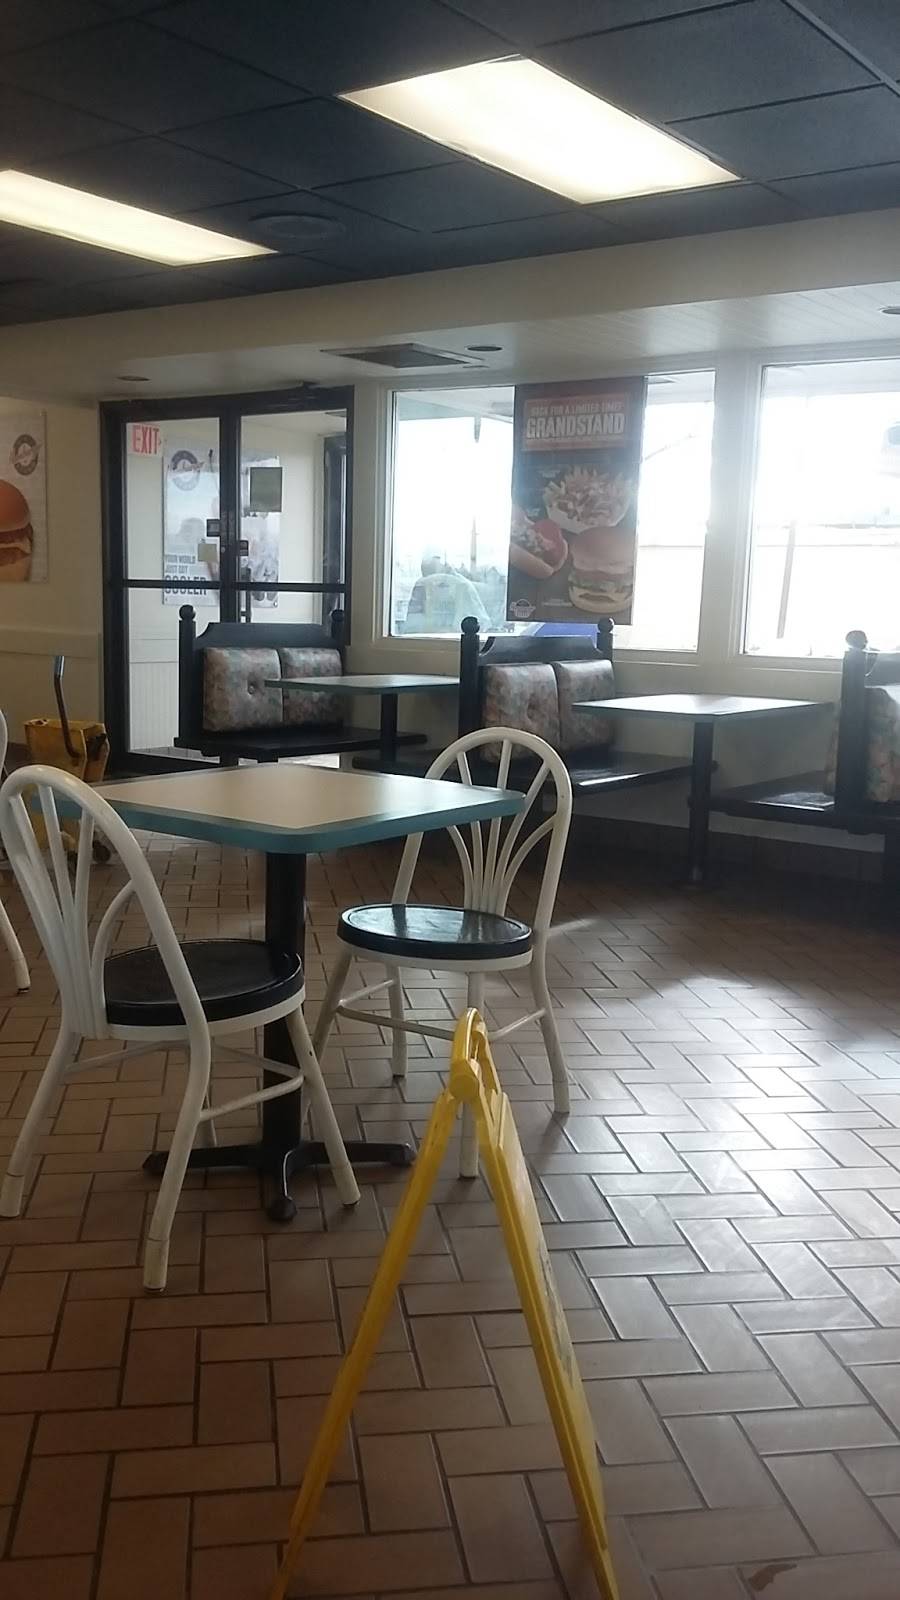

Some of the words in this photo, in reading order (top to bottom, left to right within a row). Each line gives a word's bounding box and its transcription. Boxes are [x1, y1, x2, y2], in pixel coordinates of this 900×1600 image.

[526, 413, 625, 438] GRANDSTAND
[132, 425, 160, 455] EXIT
[164, 575, 207, 595] COOLER
